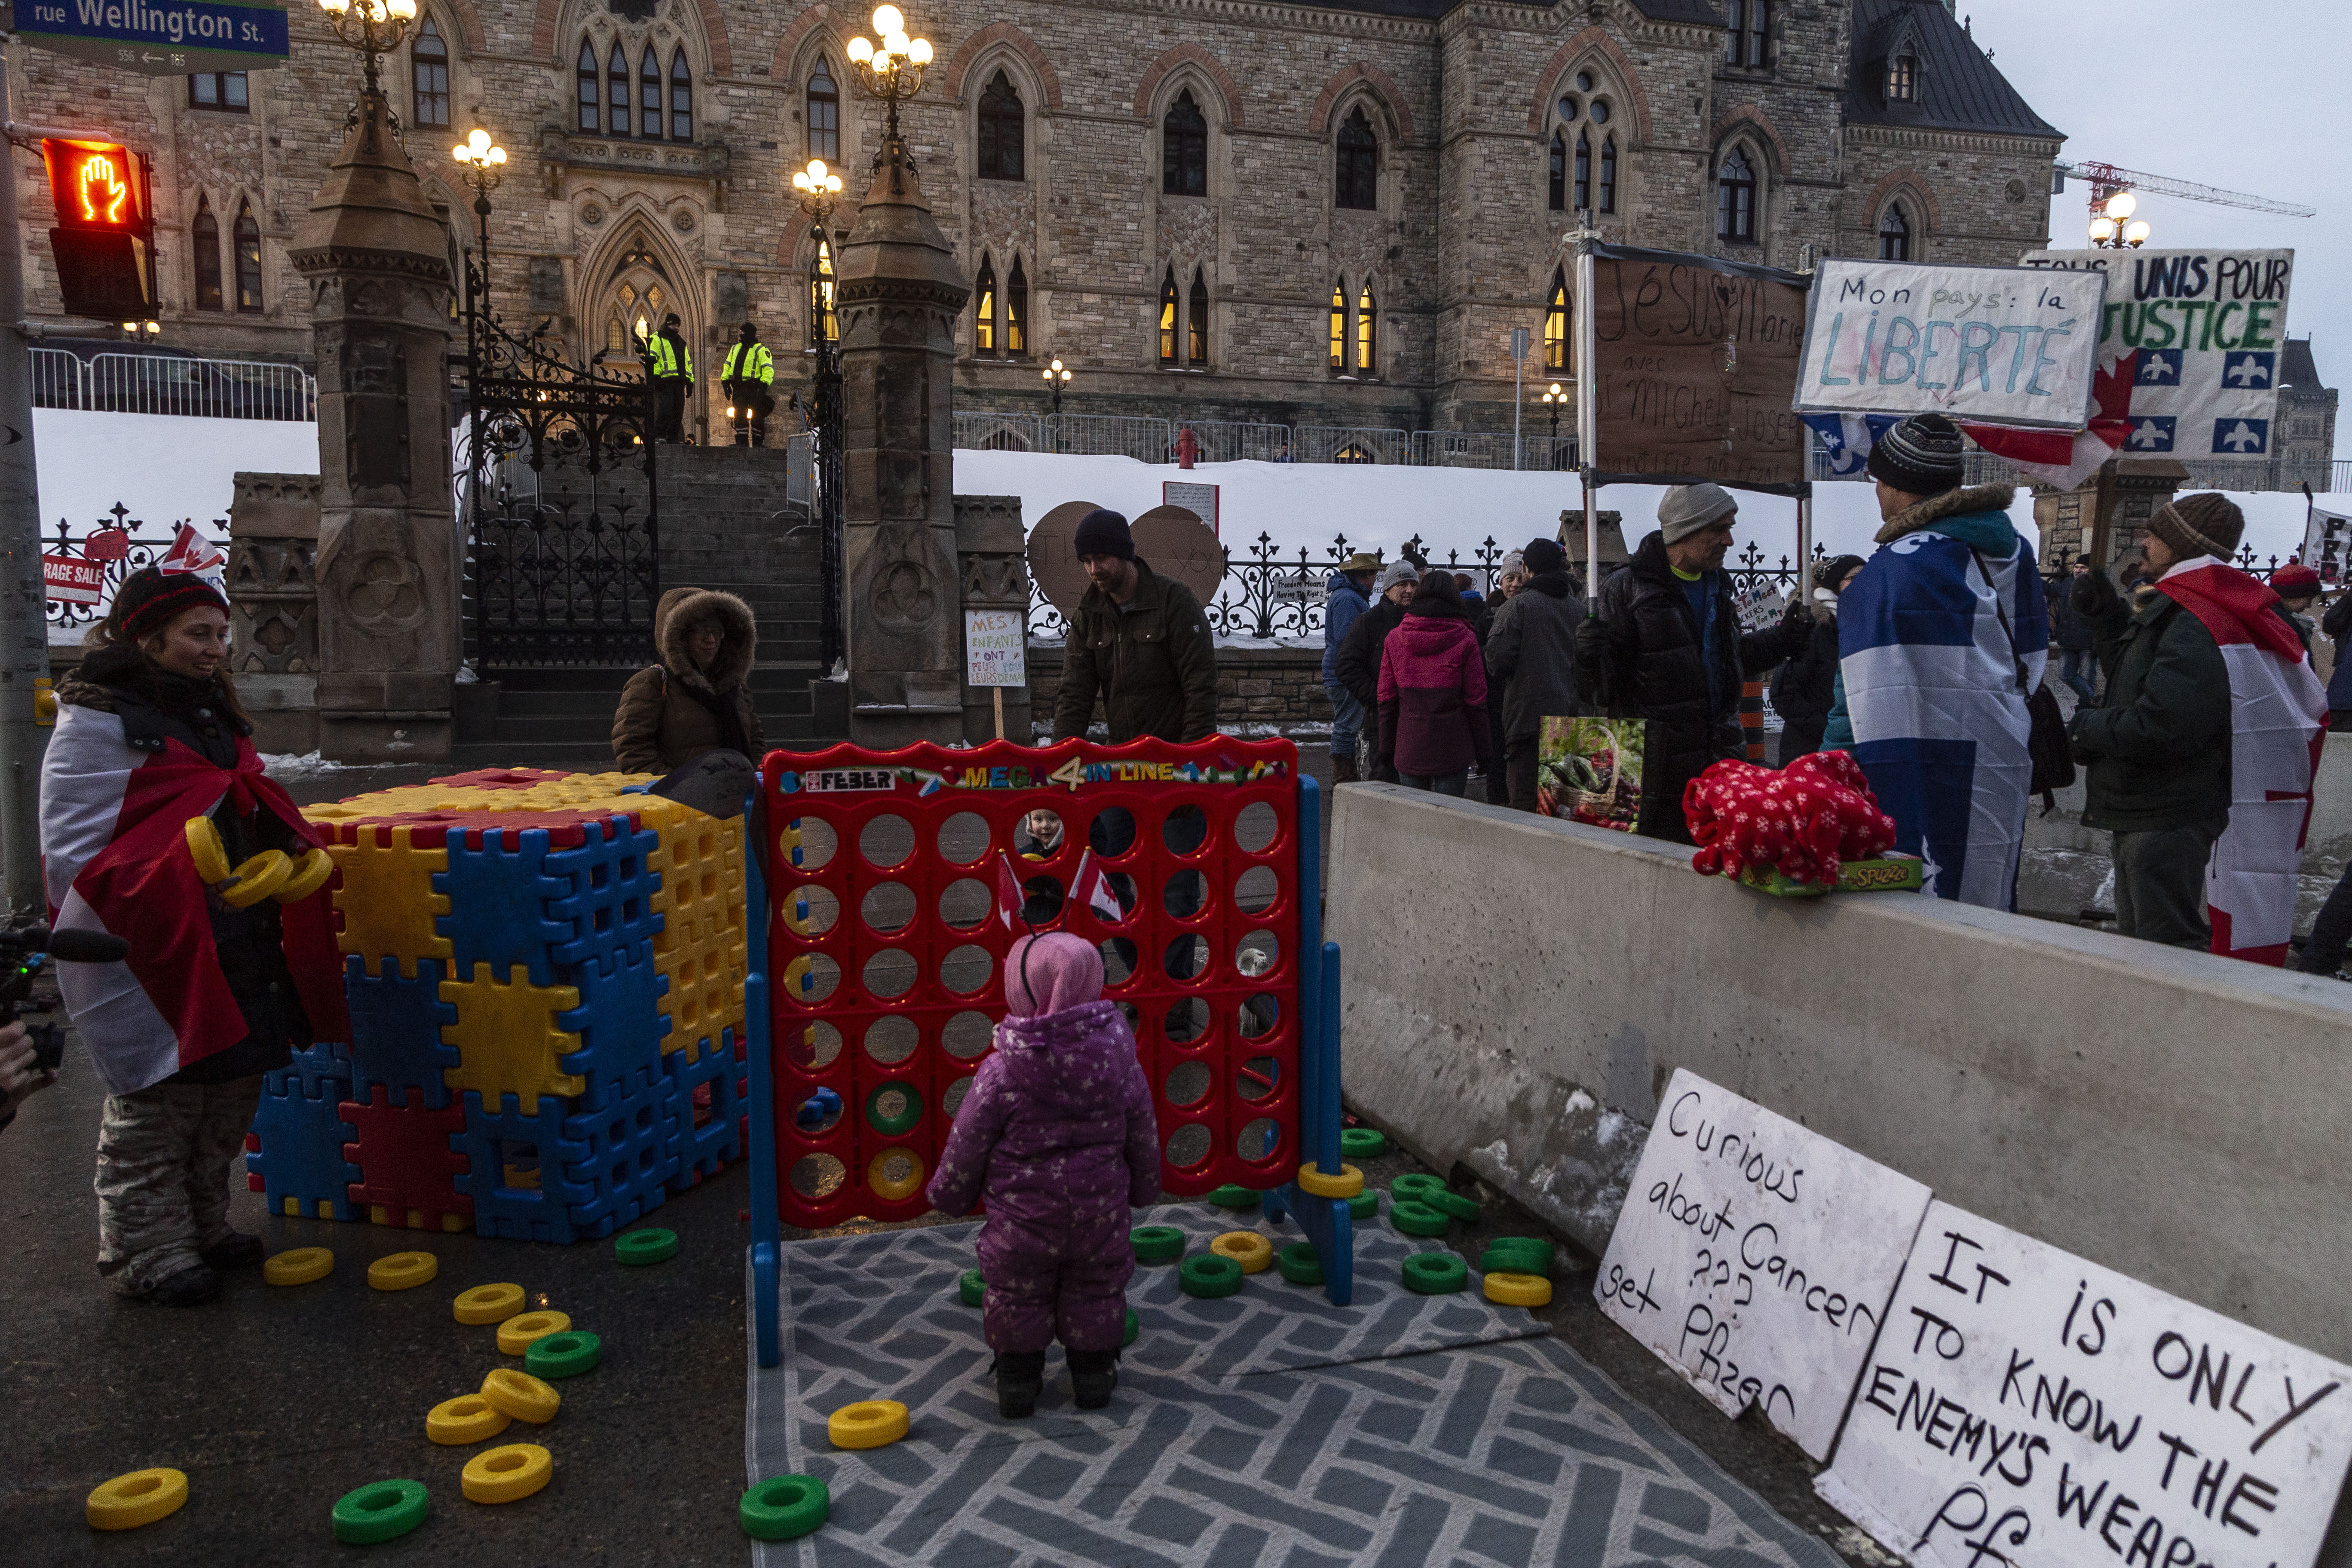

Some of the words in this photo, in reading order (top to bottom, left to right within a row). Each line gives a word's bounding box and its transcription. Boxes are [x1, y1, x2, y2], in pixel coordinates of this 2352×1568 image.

[35, 5, 66, 23] rue
[76, 0, 233, 42] Wellington
[242, 22, 264, 42] St.
[2135, 256, 2208, 301] UNIS
[2214, 257, 2289, 301] POUR
[1840, 279, 1910, 304] Mon
[2038, 287, 2065, 309] la
[2100, 300, 2278, 352] JUSTICE
[1624, 355, 1666, 372] avec
[43, 562, 73, 582] RAGE
[74, 567, 103, 585] SALE
[1278, 579, 1302, 588] Freedom
[1277, 590, 1295, 599] Having
[1738, 594, 1752, 609] To
[1752, 584, 1776, 603] Meet
[971, 615, 1008, 632] MES
[972, 634, 1023, 649] ENFANTS
[971, 661, 997, 673] PEUR
[984, 650, 1005, 661] ONT
[971, 672, 997, 684] LEURS
[821, 771, 891, 790] FEBER
[965, 766, 1049, 788] MEGA
[1050, 755, 1086, 793] 4
[1086, 763, 1112, 782] IN
[1119, 763, 1175, 782] LINE
[1669, 1091, 1804, 1203] Curious
[1649, 1173, 1735, 1243] about
[1741, 1222, 1877, 1335] Cancer
[1929, 1232, 2011, 1304] IT
[2153, 1331, 2341, 1454] ONLY
[1865, 1365, 2050, 1487] ENEMY'S
[1911, 1306, 1965, 1360] TO
[2000, 1347, 2143, 1453] KNOW
[2159, 1431, 2281, 1537] THE
